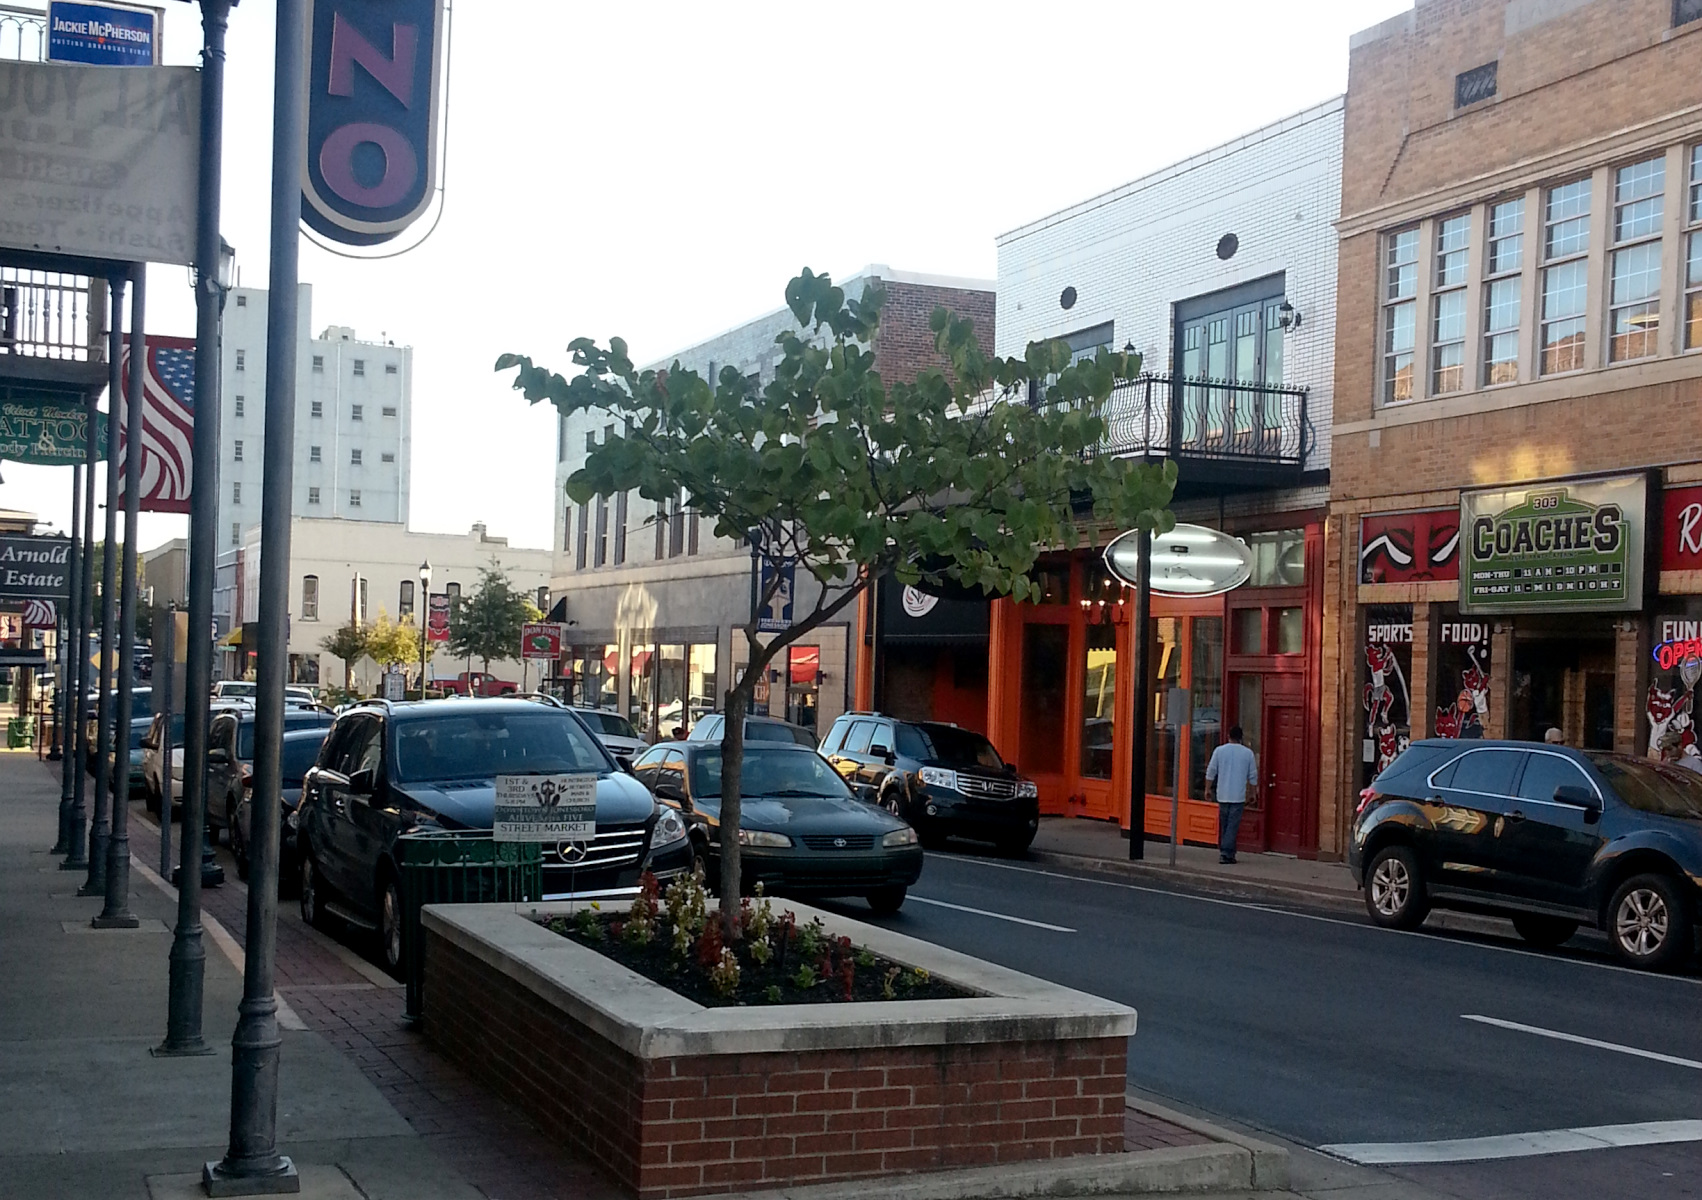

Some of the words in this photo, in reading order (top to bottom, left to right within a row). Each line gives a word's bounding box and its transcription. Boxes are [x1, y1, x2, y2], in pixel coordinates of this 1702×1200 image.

[52, 16, 88, 35] JACKIE
[1533, 496, 1558, 509] 303
[1471, 505, 1621, 561] COACHES
[0, 546, 72, 564] Arnold
[3, 569, 64, 587] Estate
[1472, 570, 1511, 580] MON-THU
[1473, 585, 1510, 595] FRI-SAT
[1368, 623, 1413, 642] SPORTS
[1441, 623, 1489, 645] FOOD!
[563, 813, 583, 821] FIVE
[500, 824, 542, 833] STREET
[544, 823, 588, 832] MARKET
